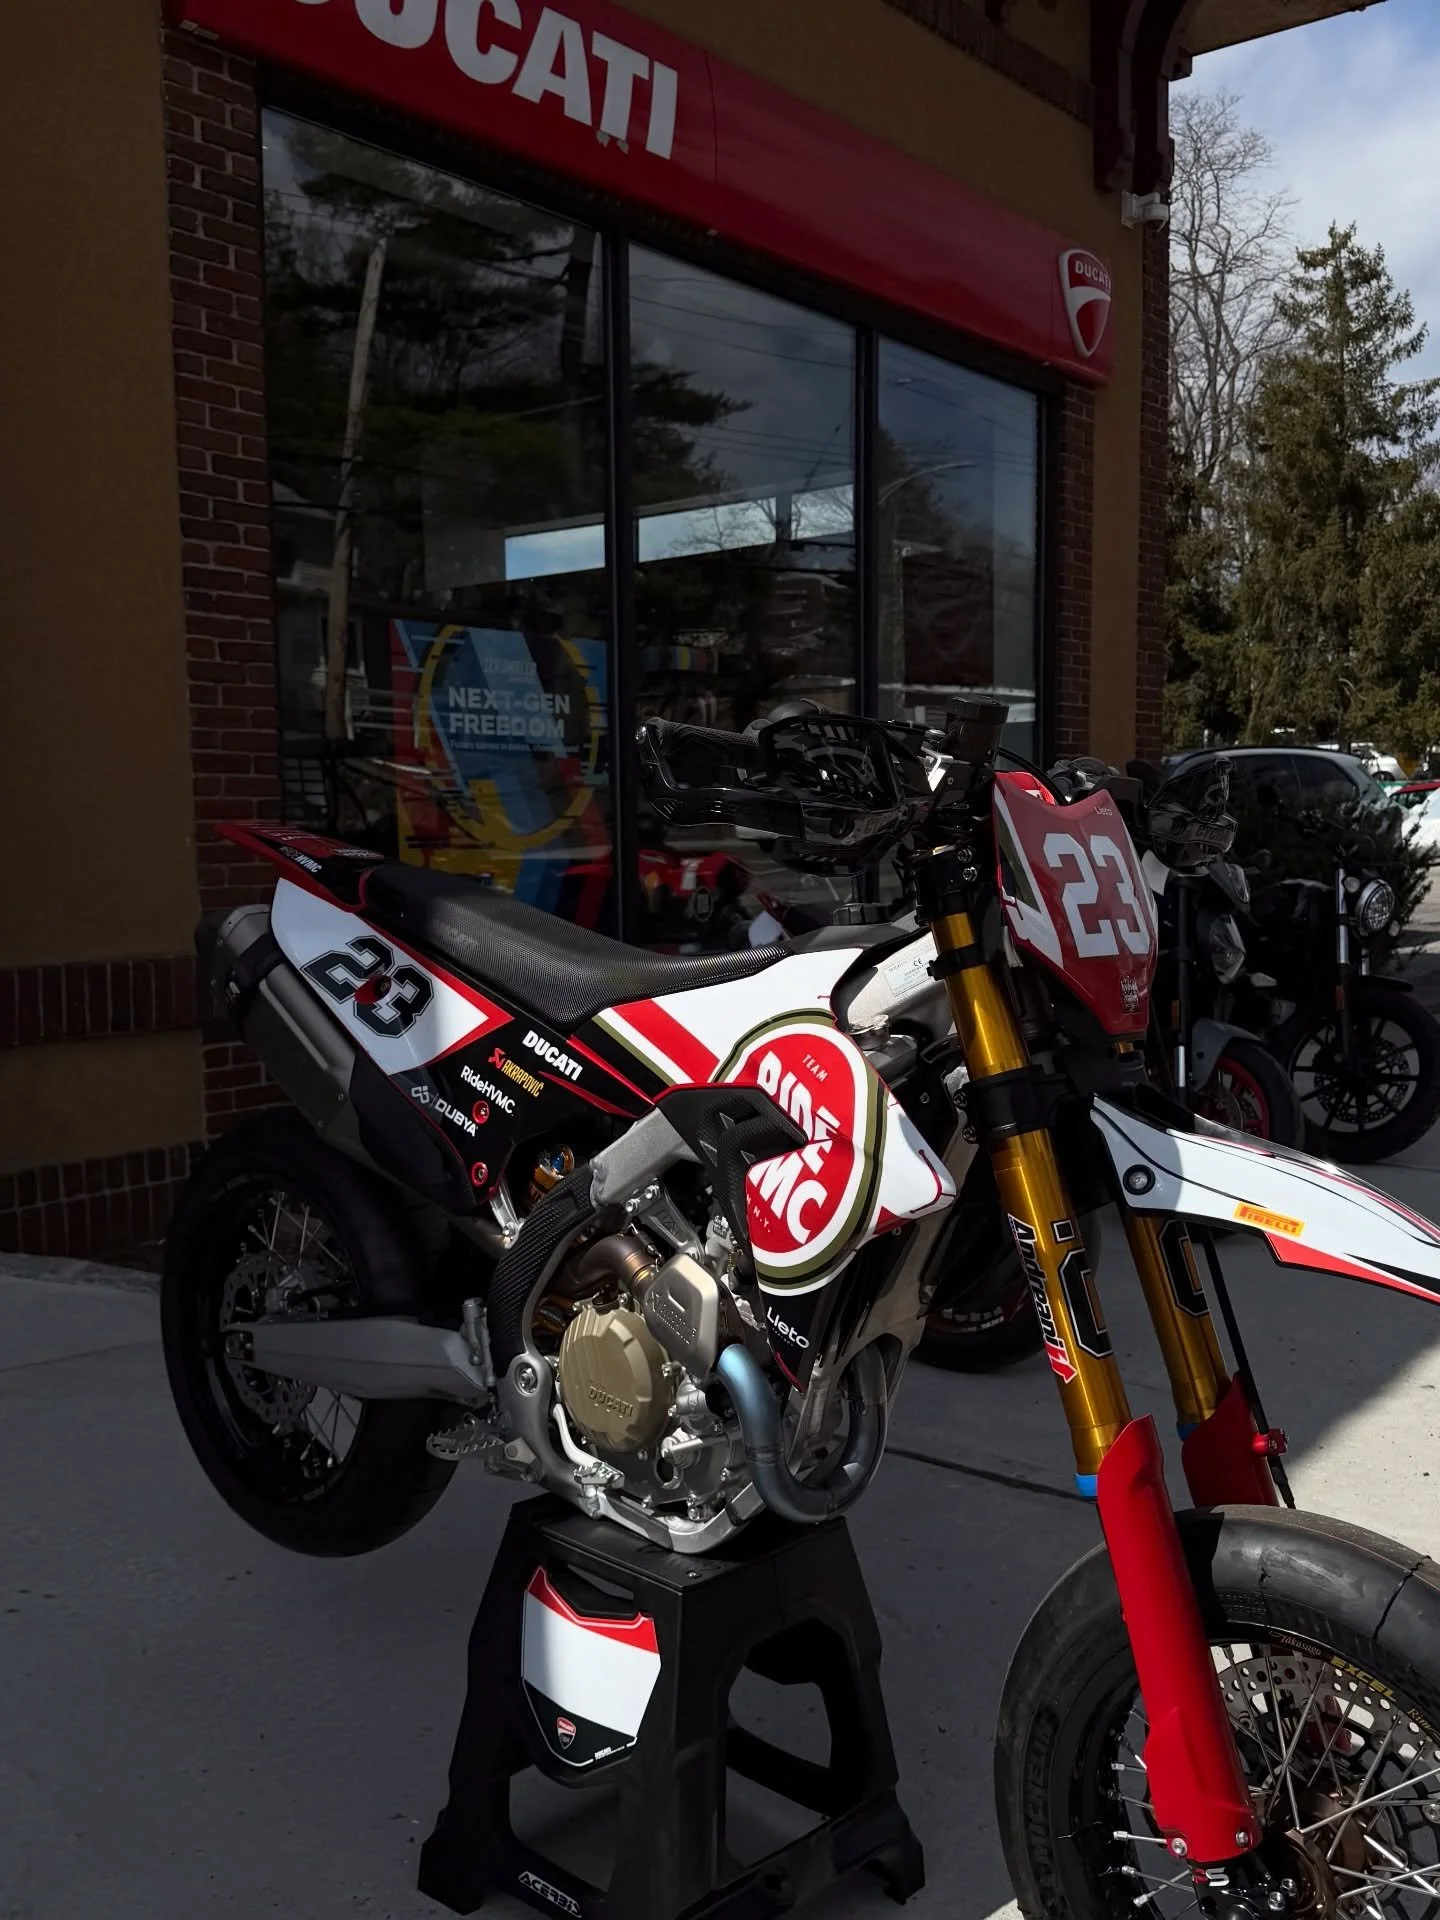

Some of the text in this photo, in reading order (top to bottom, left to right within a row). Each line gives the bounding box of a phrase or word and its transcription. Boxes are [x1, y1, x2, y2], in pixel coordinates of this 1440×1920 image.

[296, 0, 678, 160] UCATI
[1075, 260, 1111, 289] DUCATI
[448, 687, 571, 715] NEXT-GEN
[450, 713, 565, 739] FREEDOM
[1043, 833, 1150, 958] 23
[300, 935, 434, 1038] 23
[522, 1030, 583, 1081] DUCATI
[803, 1054, 829, 1082] TEAM
[434, 1098, 477, 1137] DUBYA
[1240, 1206, 1299, 1233] PIRELLI
[1008, 1213, 1067, 1351] Andreani
[588, 1385, 634, 1418] DUCATI
[1280, 1633, 1322, 1656] Takasago
[1330, 1655, 1396, 1702] EXCEL
[518, 1871, 582, 1918] ACERBIS
